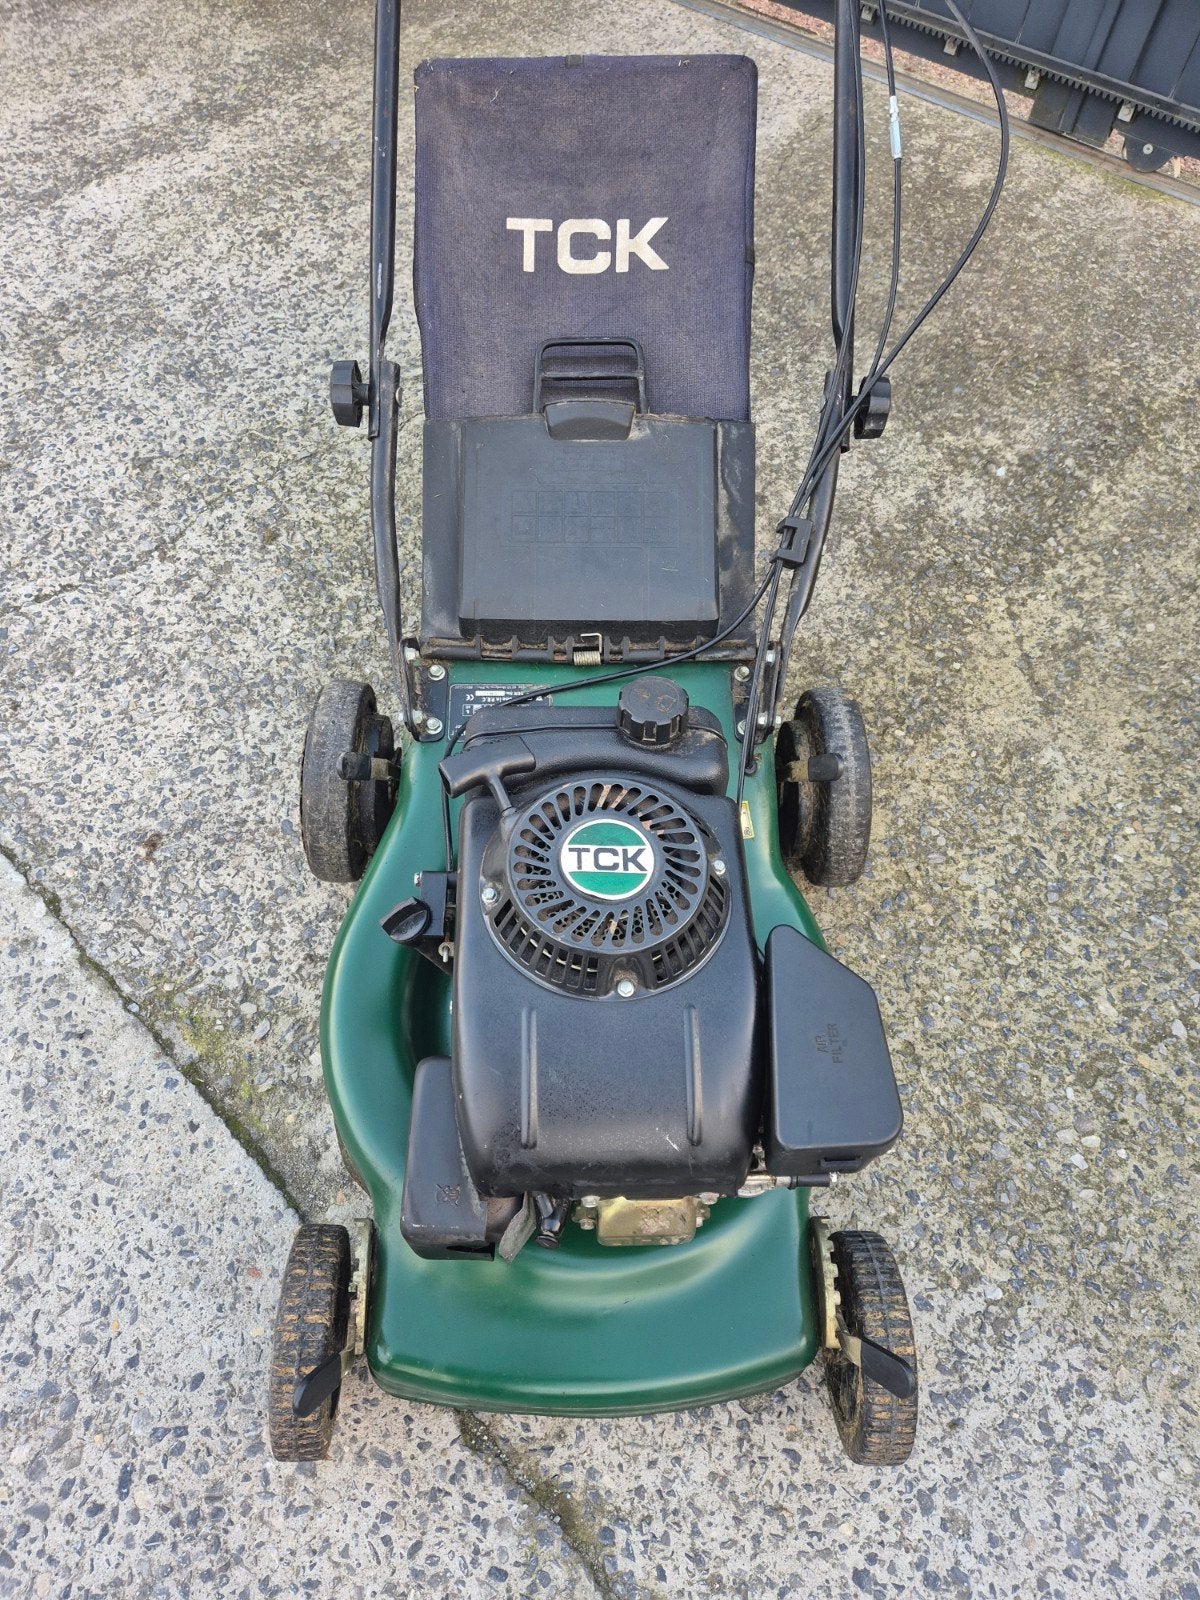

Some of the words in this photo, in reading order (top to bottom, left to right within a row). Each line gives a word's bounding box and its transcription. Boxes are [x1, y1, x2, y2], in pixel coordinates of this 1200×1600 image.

[506, 217, 669, 274] TCK
[568, 847, 648, 872] TCK
[815, 1035, 829, 1053] AIR
[827, 1023, 843, 1064] FILTER
